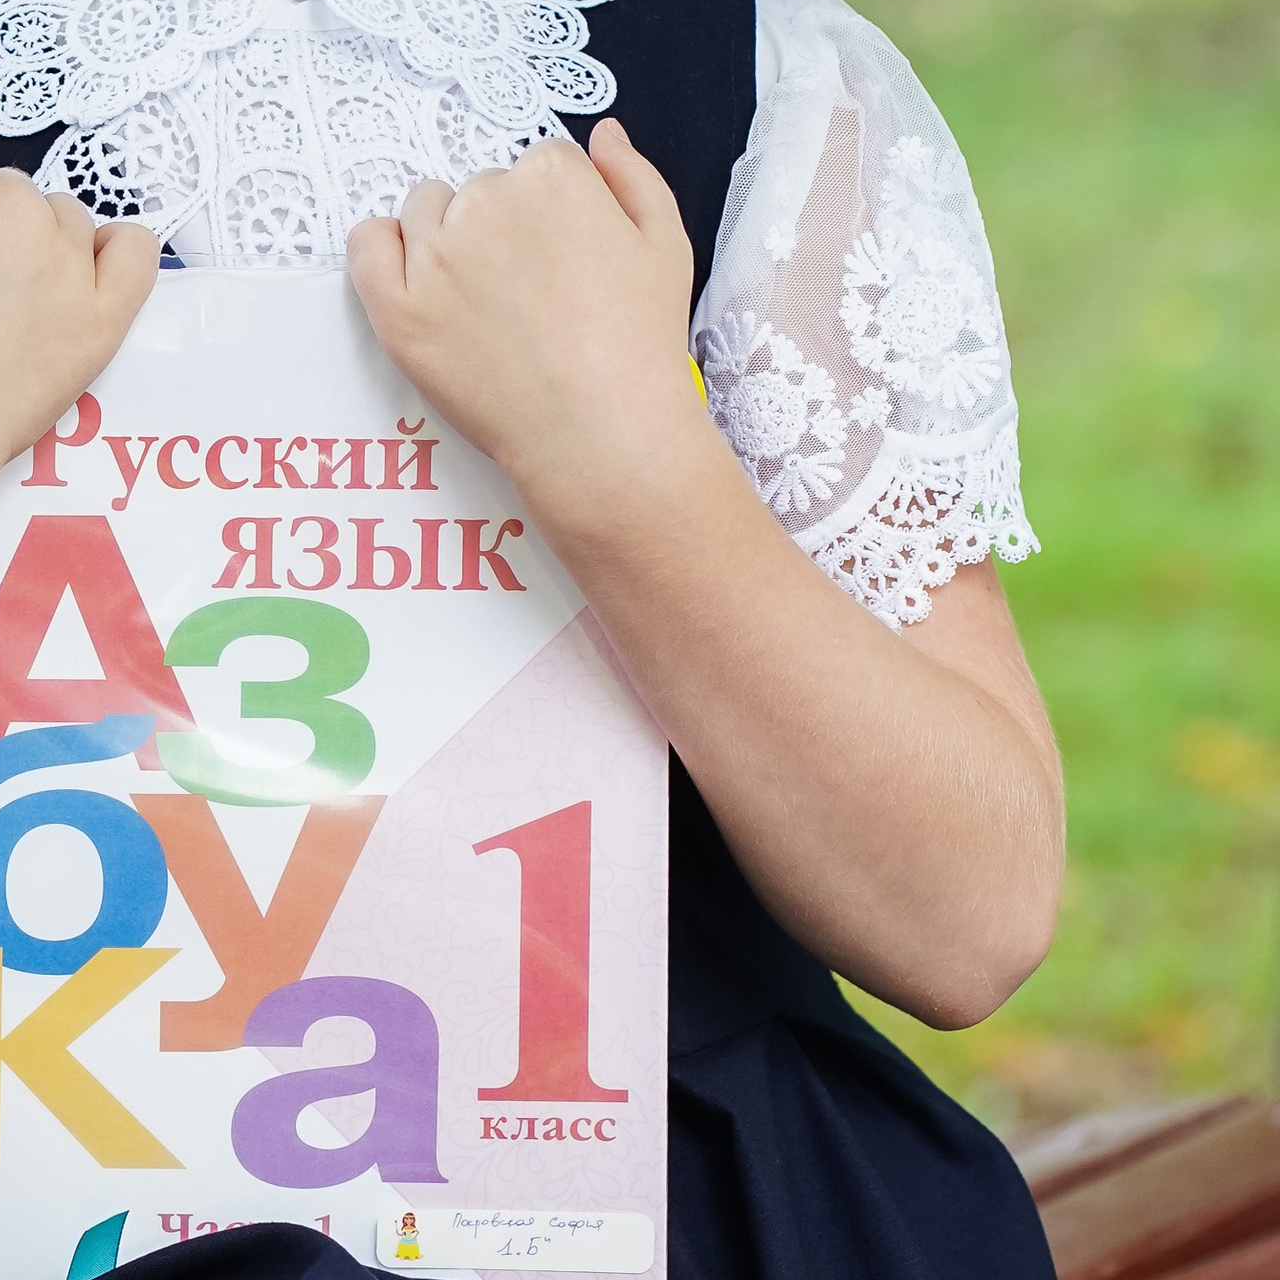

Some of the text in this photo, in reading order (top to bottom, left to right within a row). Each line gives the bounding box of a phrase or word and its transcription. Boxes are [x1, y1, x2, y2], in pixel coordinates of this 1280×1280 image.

[21, 391, 440, 511] Русский
[472, 800, 629, 1102] 1
[479, 1116, 617, 1142] класс
